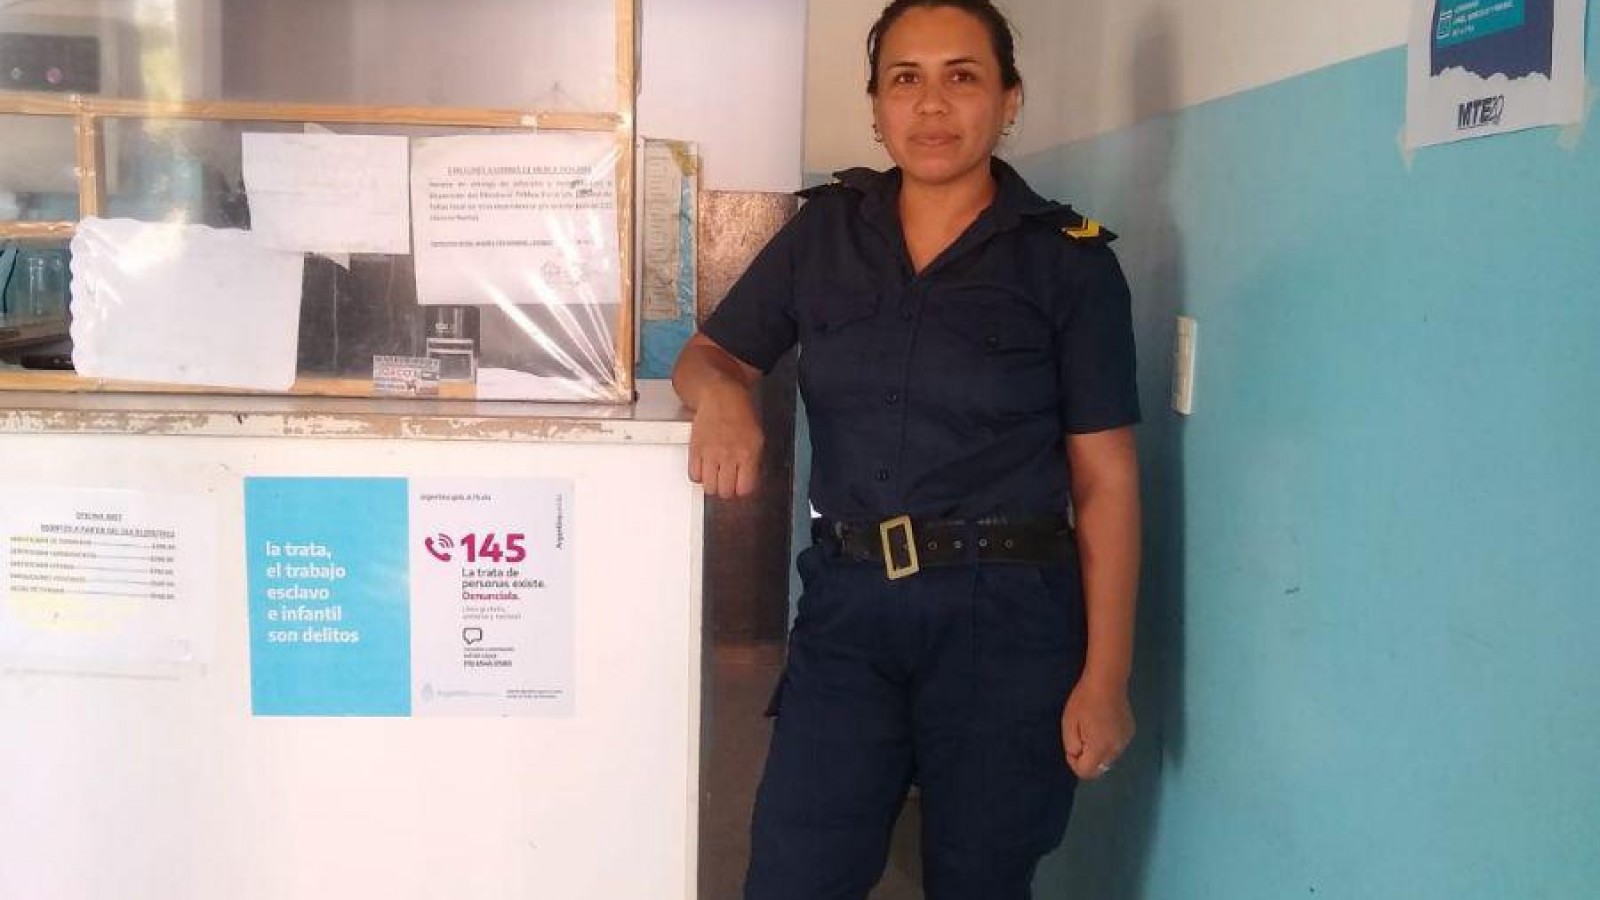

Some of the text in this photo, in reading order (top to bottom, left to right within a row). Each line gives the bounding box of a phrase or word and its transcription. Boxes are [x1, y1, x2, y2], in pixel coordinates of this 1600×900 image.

[266, 541, 332, 559] la trata,
[461, 533, 527, 563] 145
[267, 562, 347, 582] el trabajo
[462, 567, 520, 578] La trata de
[267, 584, 330, 601] esclavo
[462, 578, 546, 590] personas existe.
[267, 605, 343, 622] e infantil
[268, 626, 360, 643] son delitos
